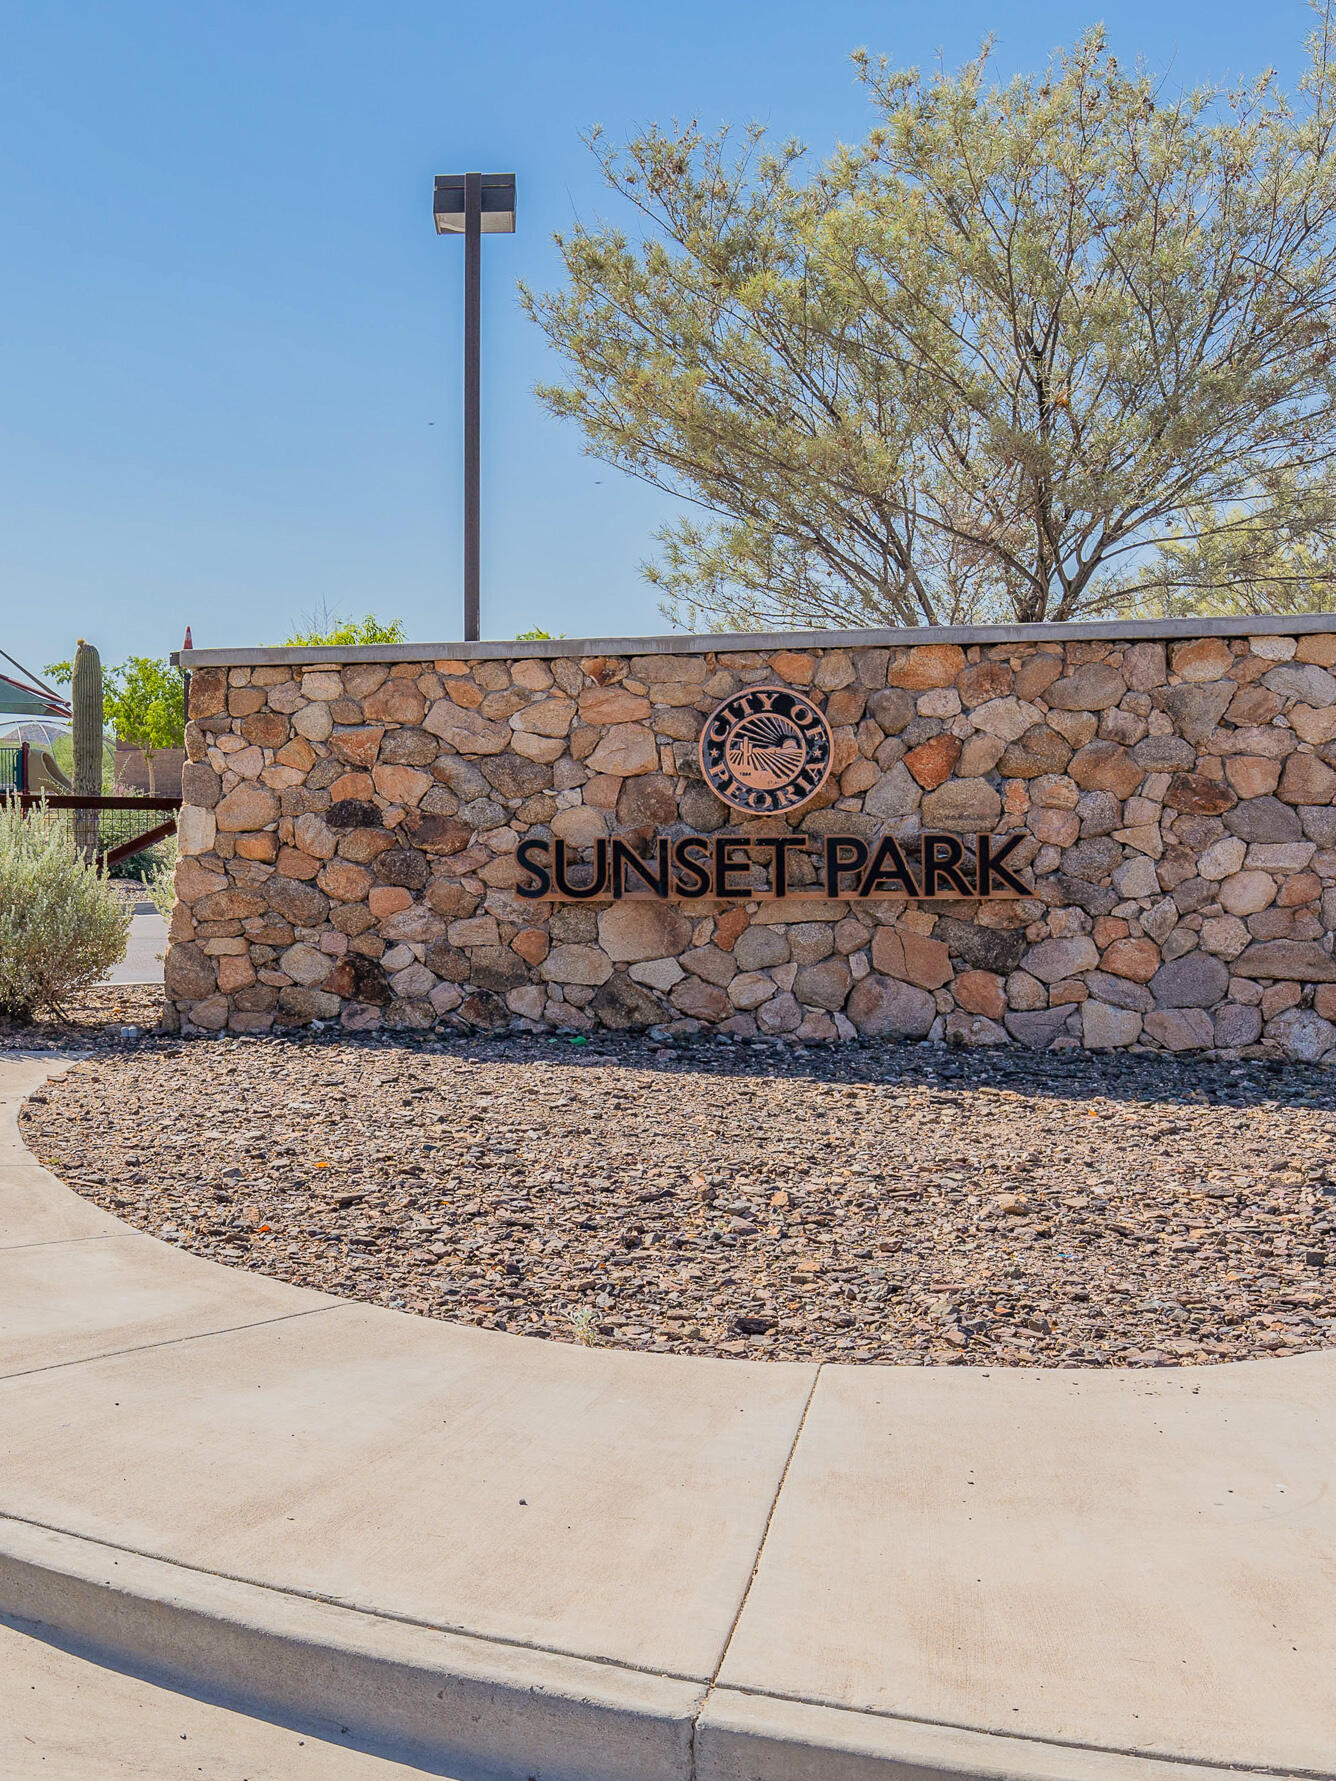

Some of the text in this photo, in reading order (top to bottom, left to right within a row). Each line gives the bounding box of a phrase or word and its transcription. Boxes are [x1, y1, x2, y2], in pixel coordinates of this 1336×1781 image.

[709, 693, 827, 743] CITY OF
[708, 761, 827, 808] PEORIA
[515, 833, 1035, 899] SUNSET PARK
